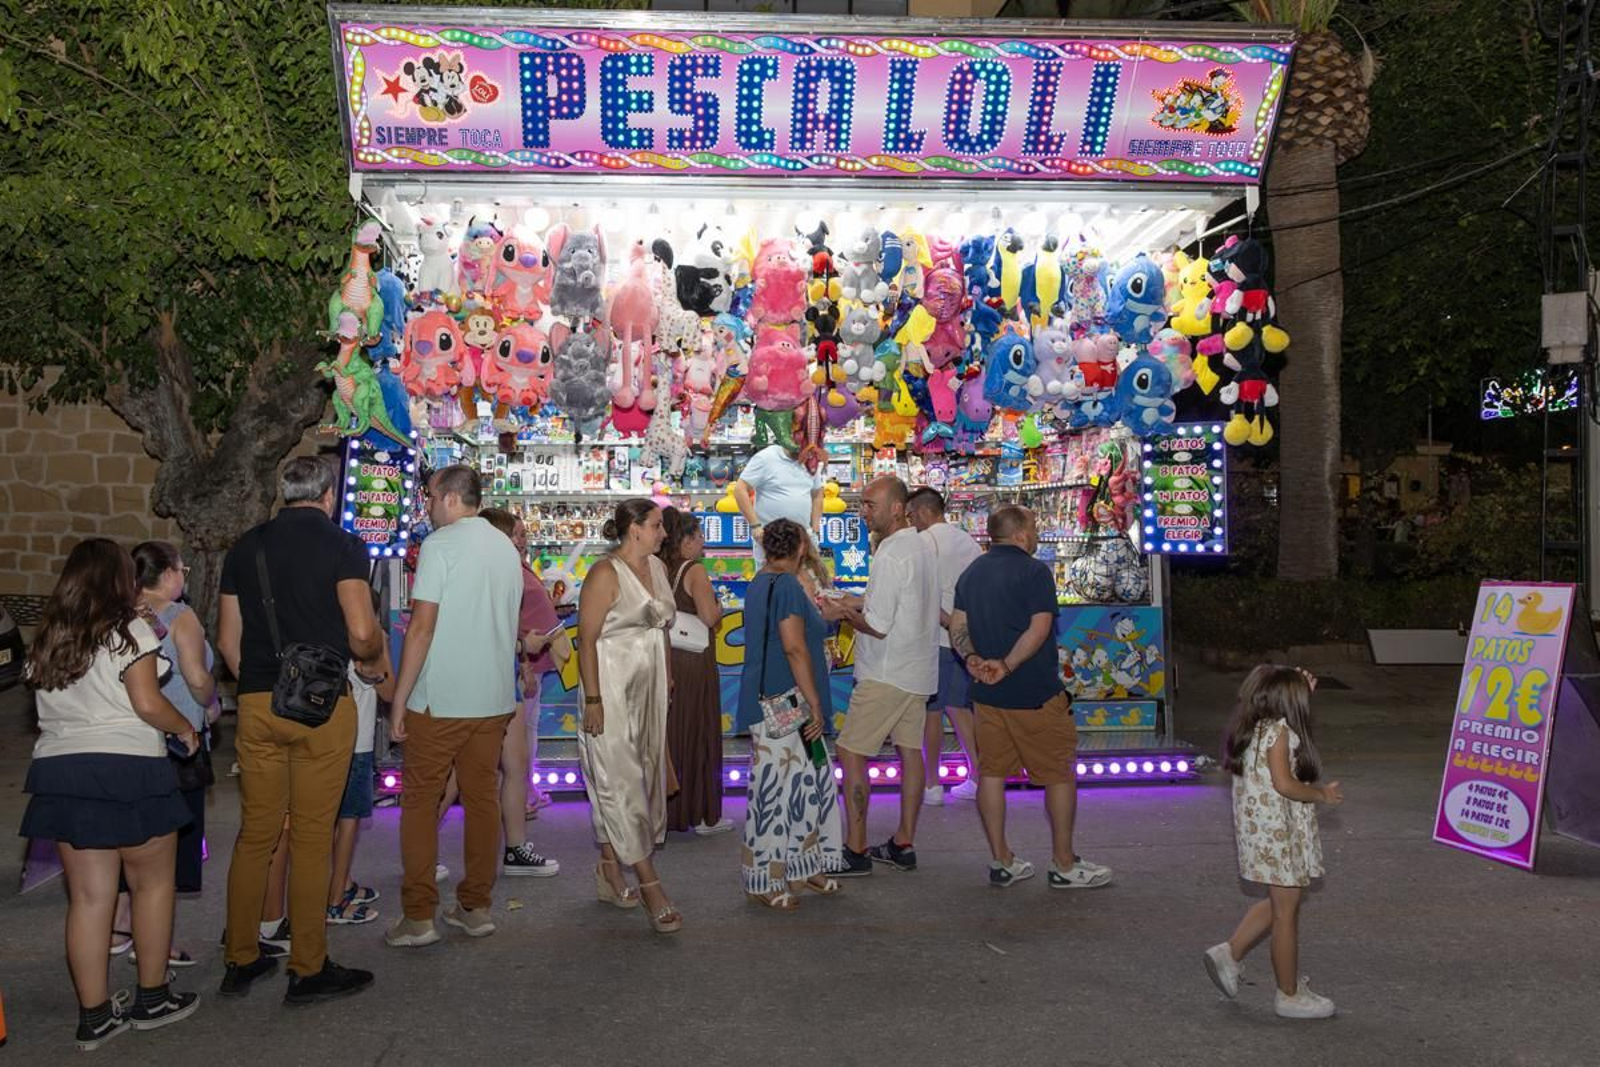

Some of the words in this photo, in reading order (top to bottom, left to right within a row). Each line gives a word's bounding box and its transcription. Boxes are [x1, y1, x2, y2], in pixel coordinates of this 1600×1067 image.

[518, 51, 858, 154] PESCA
[881, 57, 1123, 157] LOLI
[375, 126, 449, 146] SIEMPRE
[458, 128, 503, 148] TOCA
[1208, 140, 1247, 157] TOCA
[1160, 439, 1169, 451] 4
[1171, 438, 1206, 450] PATOS
[361, 464, 369, 476] 8
[371, 465, 400, 478] PATOS
[1160, 465, 1170, 477] 8
[1172, 463, 1207, 477] PATOS
[358, 490, 369, 502] 14
[371, 491, 399, 503] PATOS
[1158, 491, 1171, 502] 14
[1172, 490, 1209, 502] PATOS
[353, 518, 388, 530] PREMIO
[389, 518, 397, 530] A
[1157, 516, 1199, 528] PREMIO
[1200, 516, 1210, 528] A
[1164, 529, 1203, 541] ELEGIR
[1480, 592, 1515, 625] 14
[1471, 635, 1536, 665] PATOS
[1459, 664, 1551, 728] 12€
[1459, 719, 1541, 744] PREMIO
[1453, 738, 1466, 751] A
[1471, 741, 1541, 766] ELEGIR
[1475, 784, 1497, 797] PATOS
[1472, 797, 1495, 811] PATOS
[1471, 811, 1494, 824] PATOS
